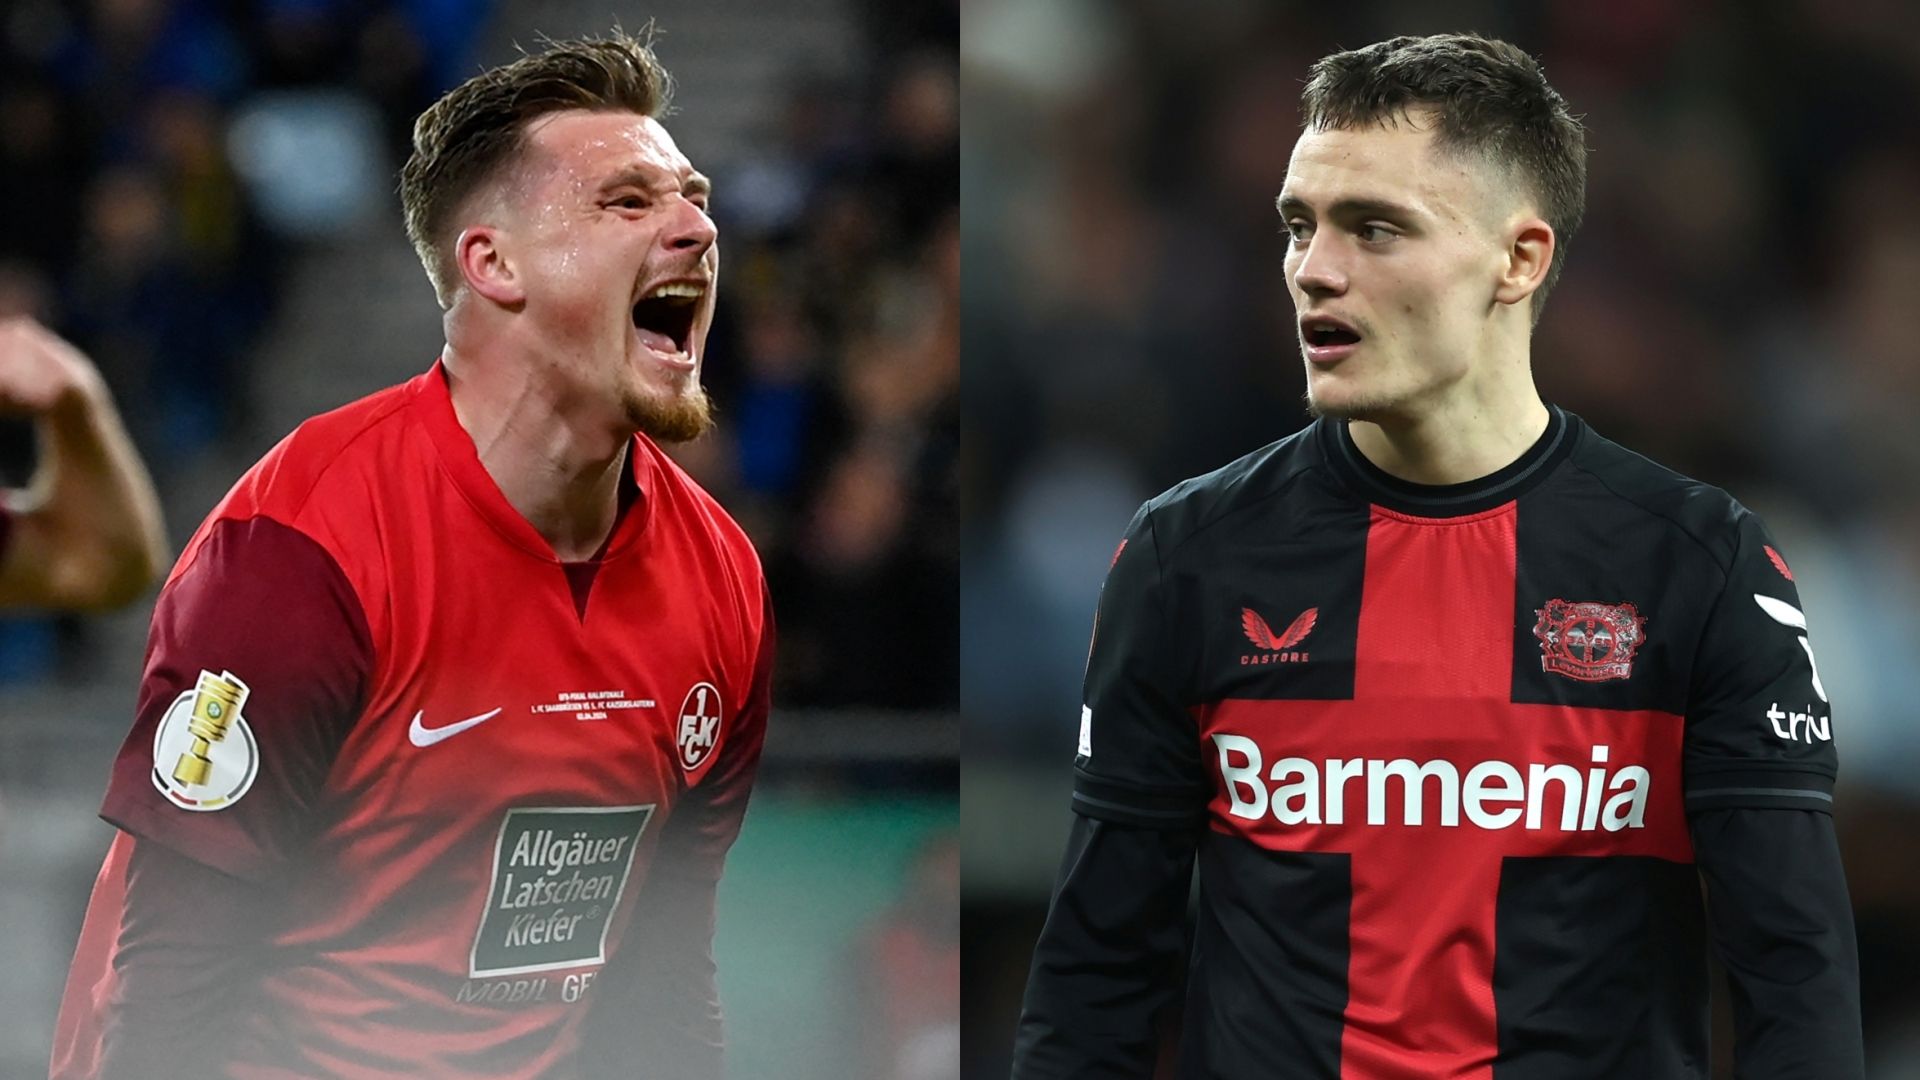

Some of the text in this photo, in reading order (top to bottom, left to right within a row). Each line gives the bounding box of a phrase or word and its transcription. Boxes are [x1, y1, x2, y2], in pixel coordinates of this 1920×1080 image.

[1241, 652, 1309, 665] CASTORE
[1551, 658, 1624, 678] Leverkusen
[1211, 734, 1650, 831] Barmenia
[509, 830, 628, 876] Allgäuer
[500, 871, 613, 909] Latschen
[504, 908, 583, 947] Kiefer
[456, 972, 597, 1003] MOBIL GE
